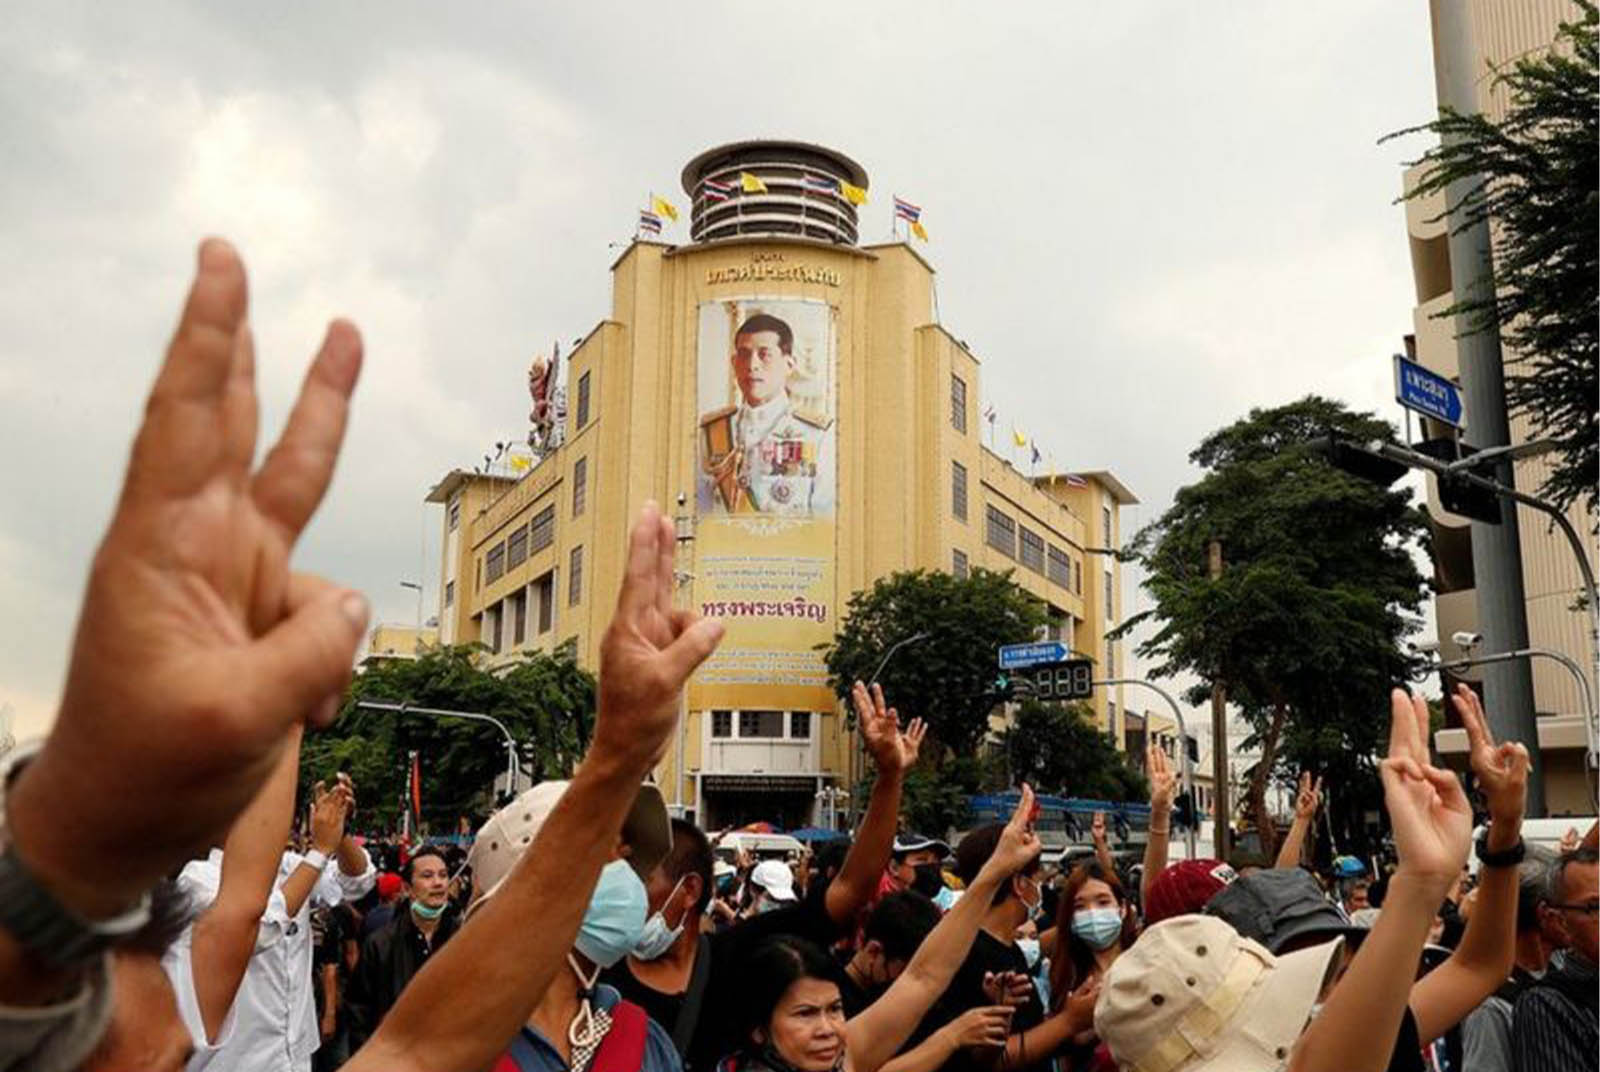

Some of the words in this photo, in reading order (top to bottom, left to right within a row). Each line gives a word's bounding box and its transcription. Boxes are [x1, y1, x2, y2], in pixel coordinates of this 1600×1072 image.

[702, 597, 826, 623] ทรงพระเจริญ
